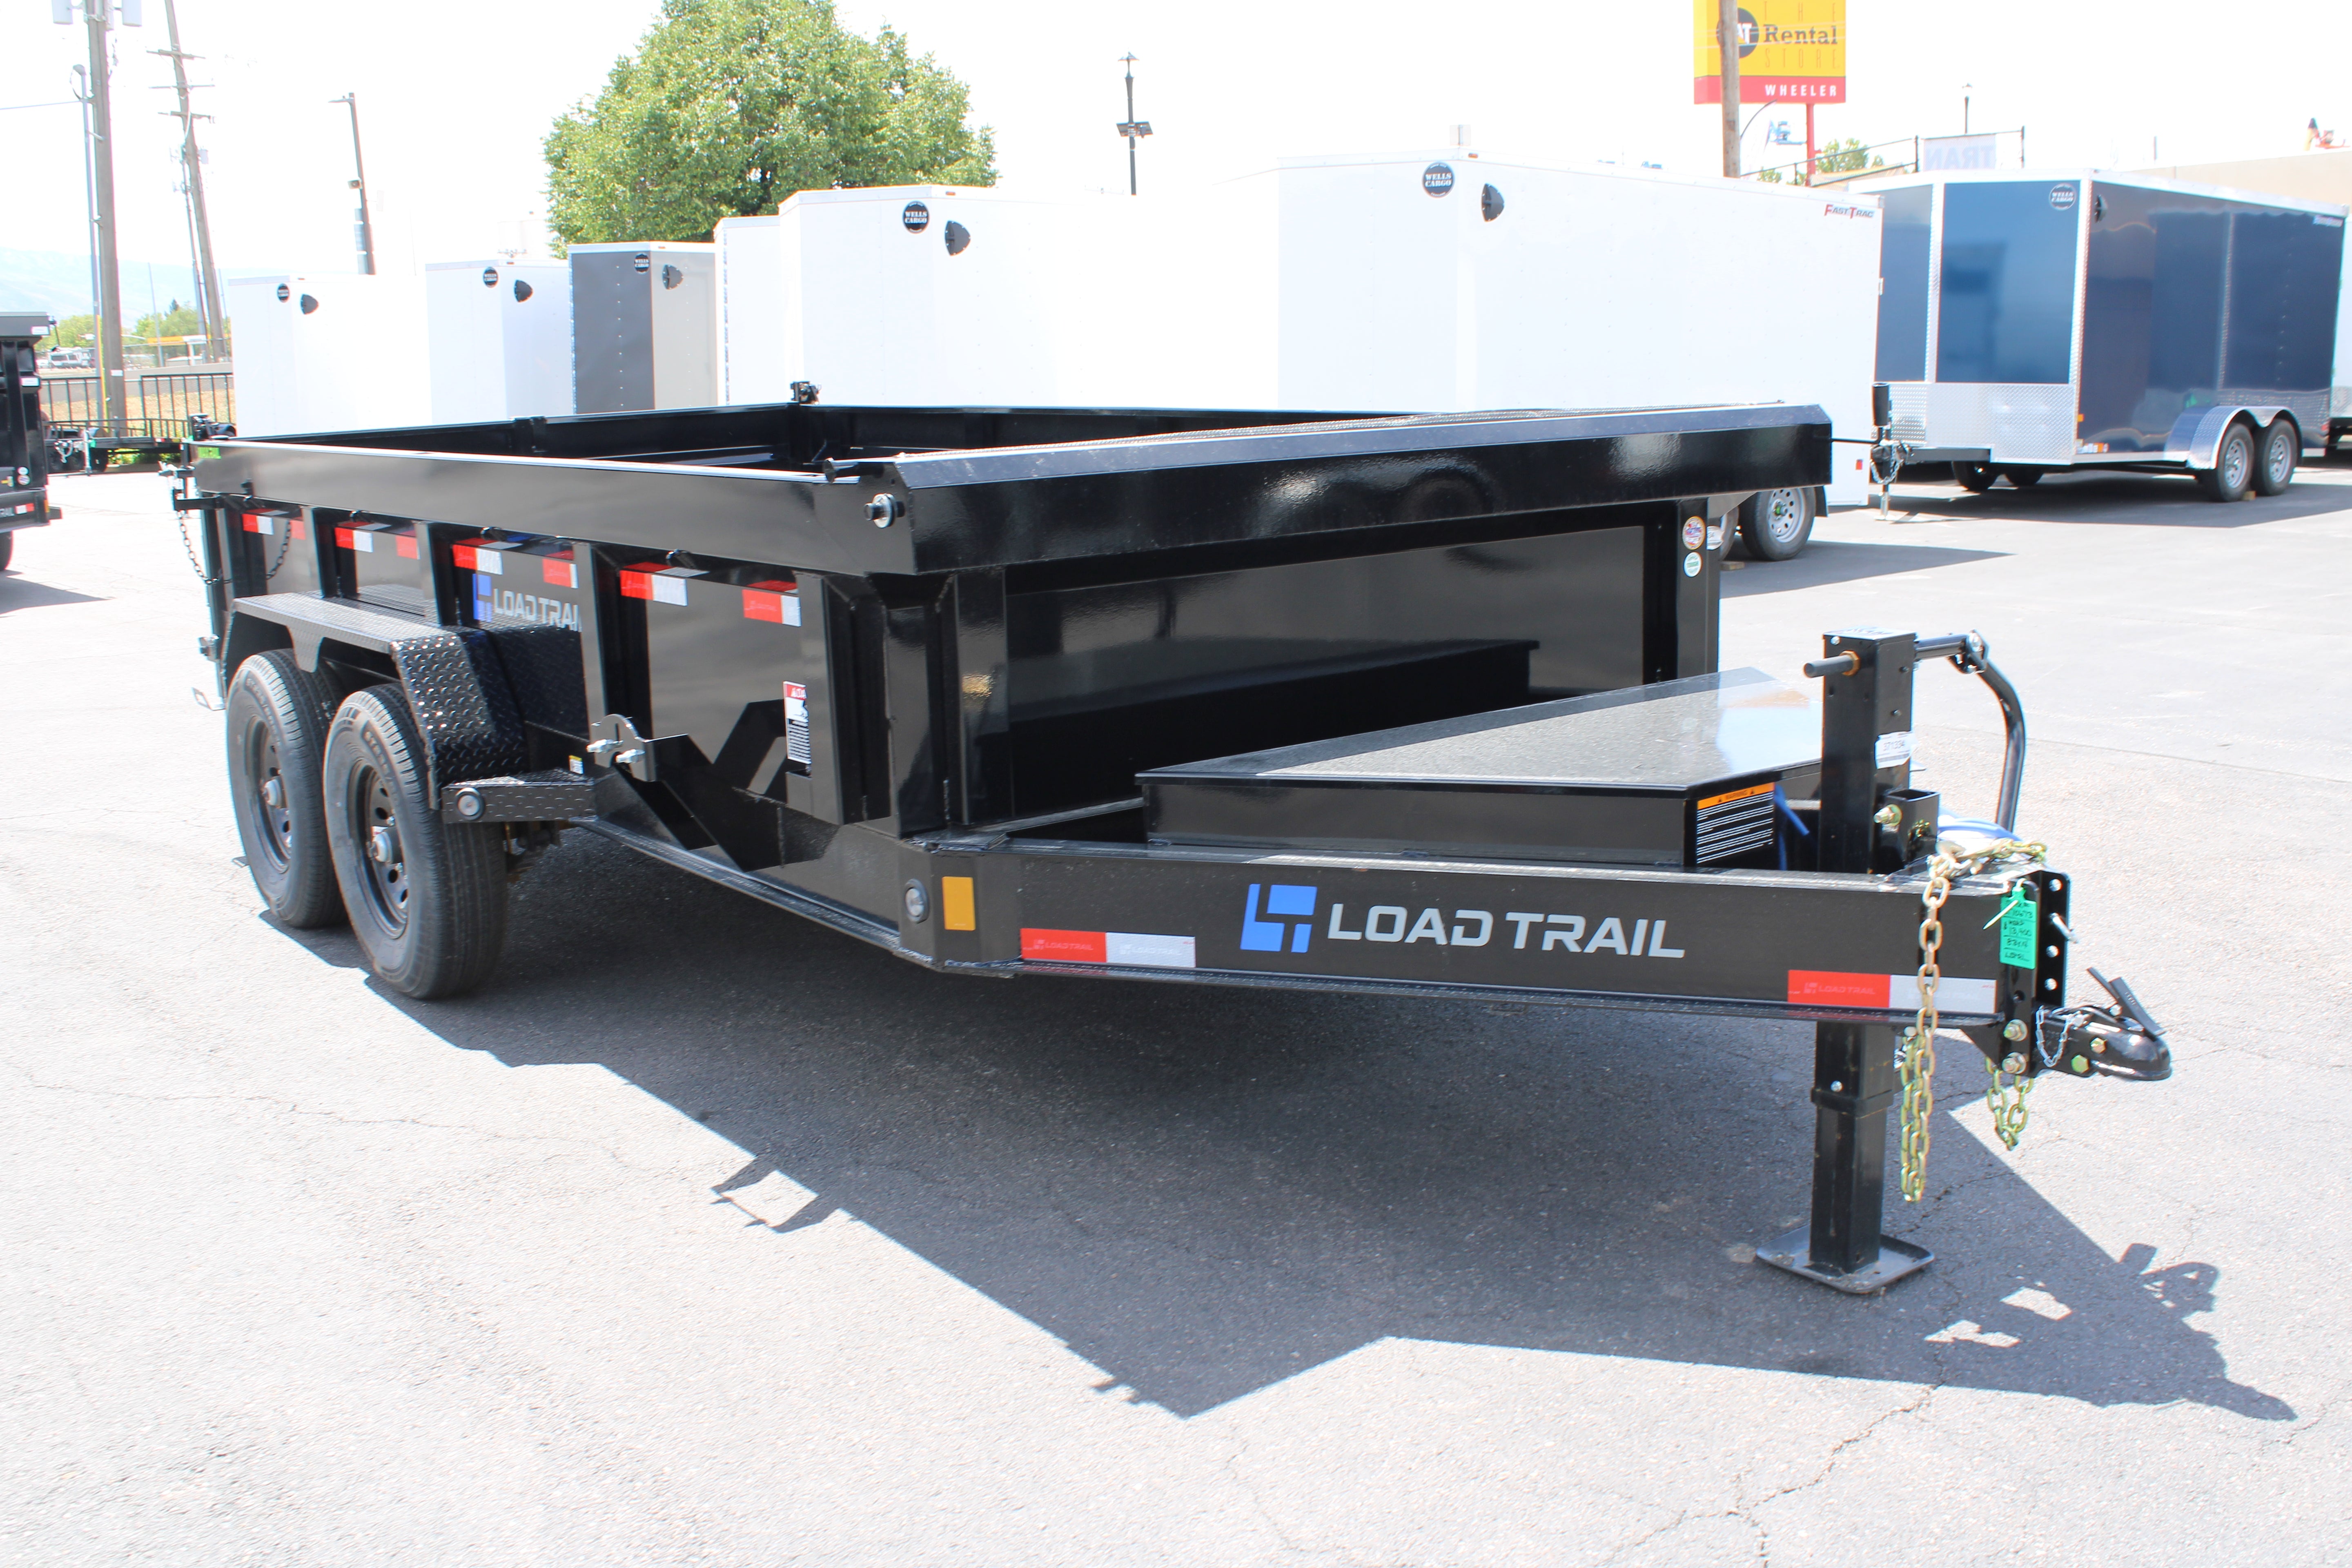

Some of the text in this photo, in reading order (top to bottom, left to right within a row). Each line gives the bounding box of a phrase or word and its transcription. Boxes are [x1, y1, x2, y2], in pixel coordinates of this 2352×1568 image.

[1764, 24, 1838, 45] Rental
[1765, 48, 1837, 69] STORE
[1765, 84, 1837, 97] WHEELER
[1425, 172, 1452, 181] WELLS
[493, 588, 583, 633] LOAD TRAI
[1327, 903, 1686, 959] LOAD TRAIL
